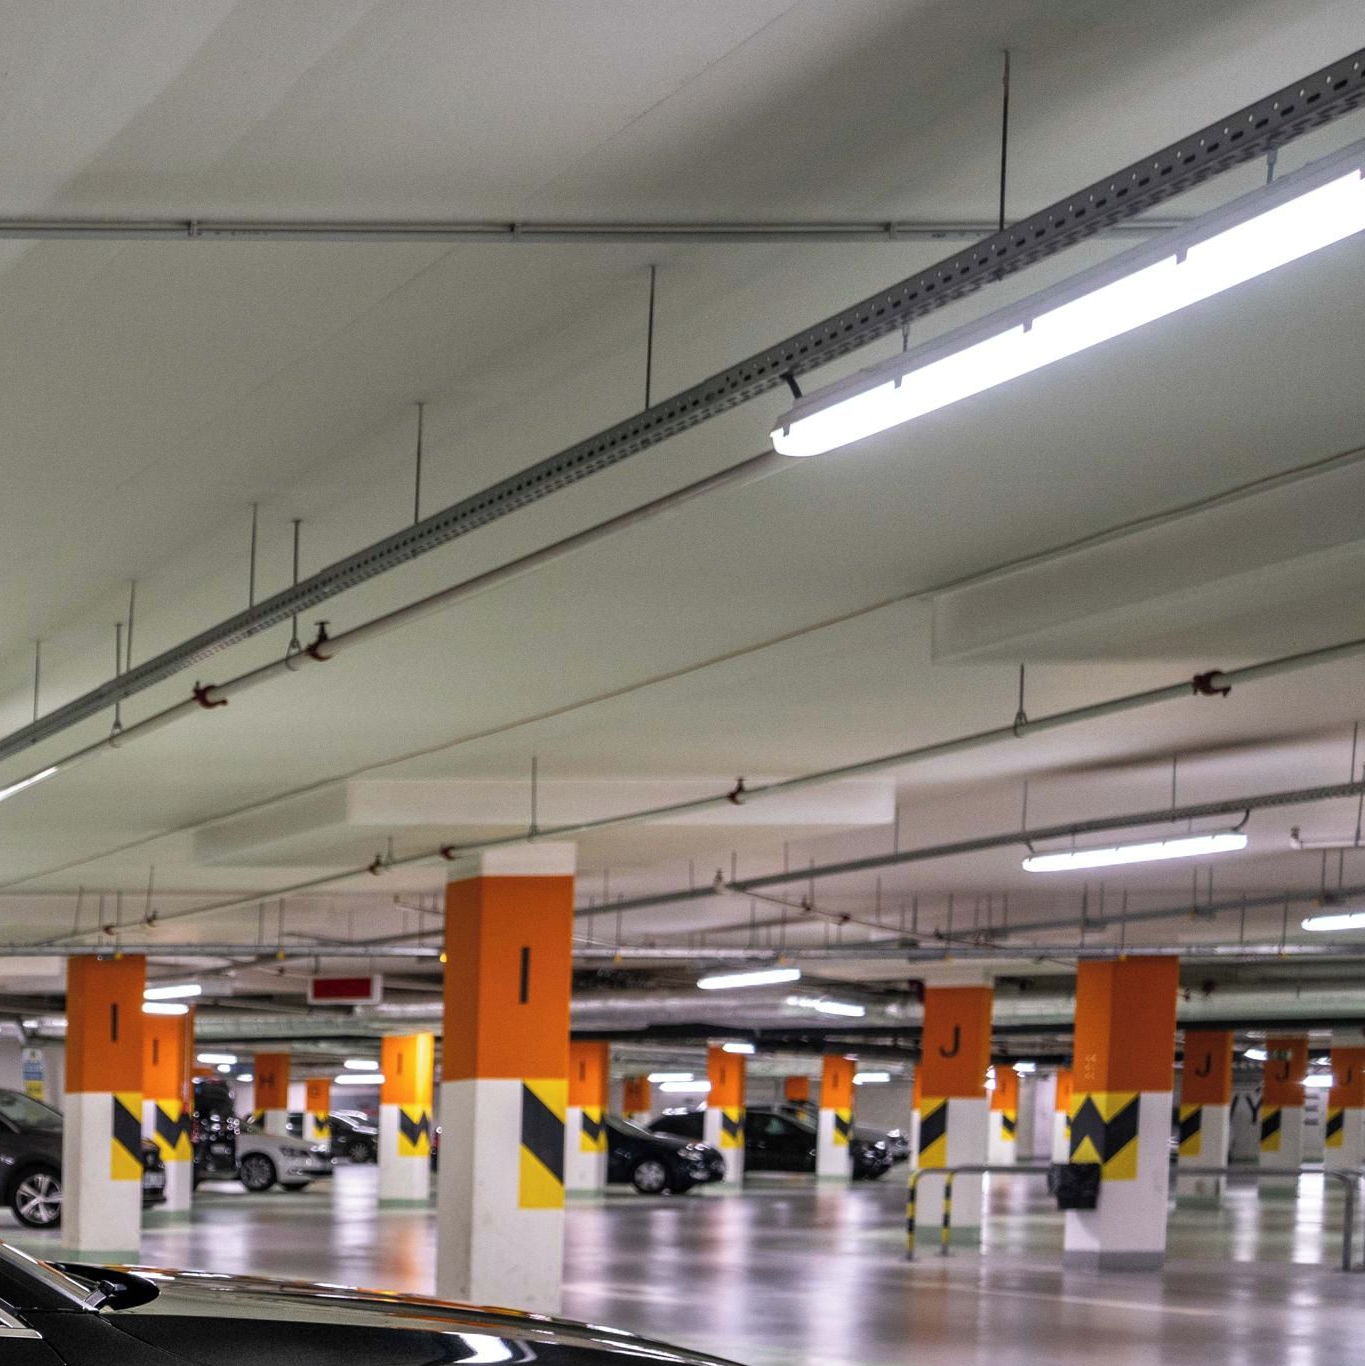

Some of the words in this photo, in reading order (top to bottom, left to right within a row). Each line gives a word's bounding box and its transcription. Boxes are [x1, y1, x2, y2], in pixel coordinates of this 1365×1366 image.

[521, 946, 530, 1004] I
[111, 1003, 118, 1043] I
[939, 1026, 960, 1058] J
[1195, 1052, 1212, 1077] J
[1275, 1061, 1290, 1082] J
